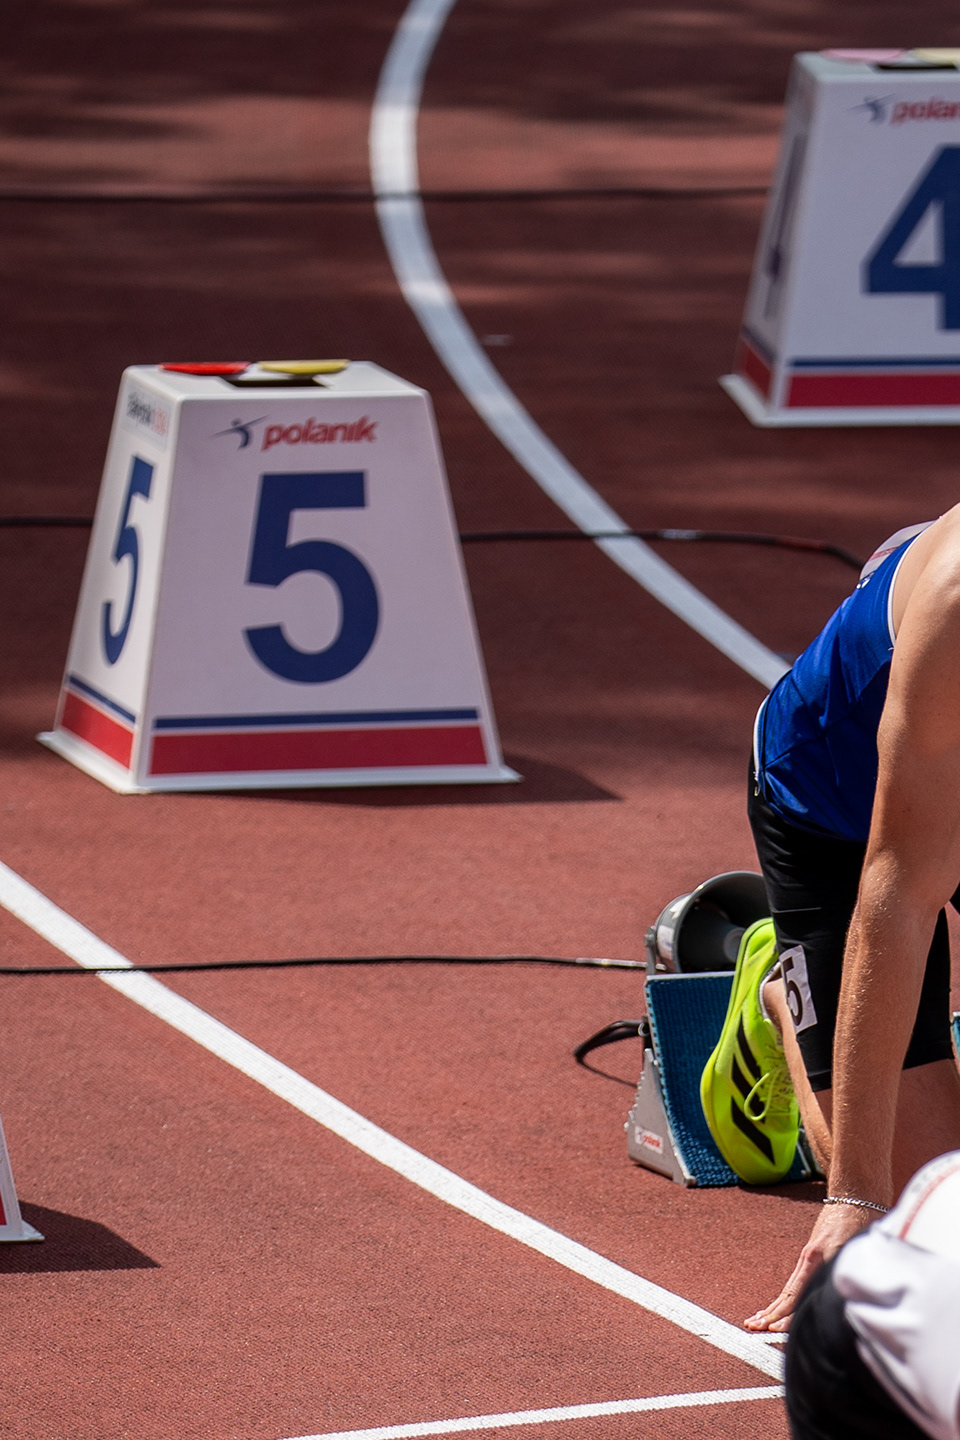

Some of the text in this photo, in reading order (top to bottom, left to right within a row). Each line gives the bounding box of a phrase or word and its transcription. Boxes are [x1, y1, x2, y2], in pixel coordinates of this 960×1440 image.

[260, 415, 380, 452] polanik
[101, 454, 155, 667] 5
[242, 469, 381, 685] 5
[781, 956, 804, 1027] 5
